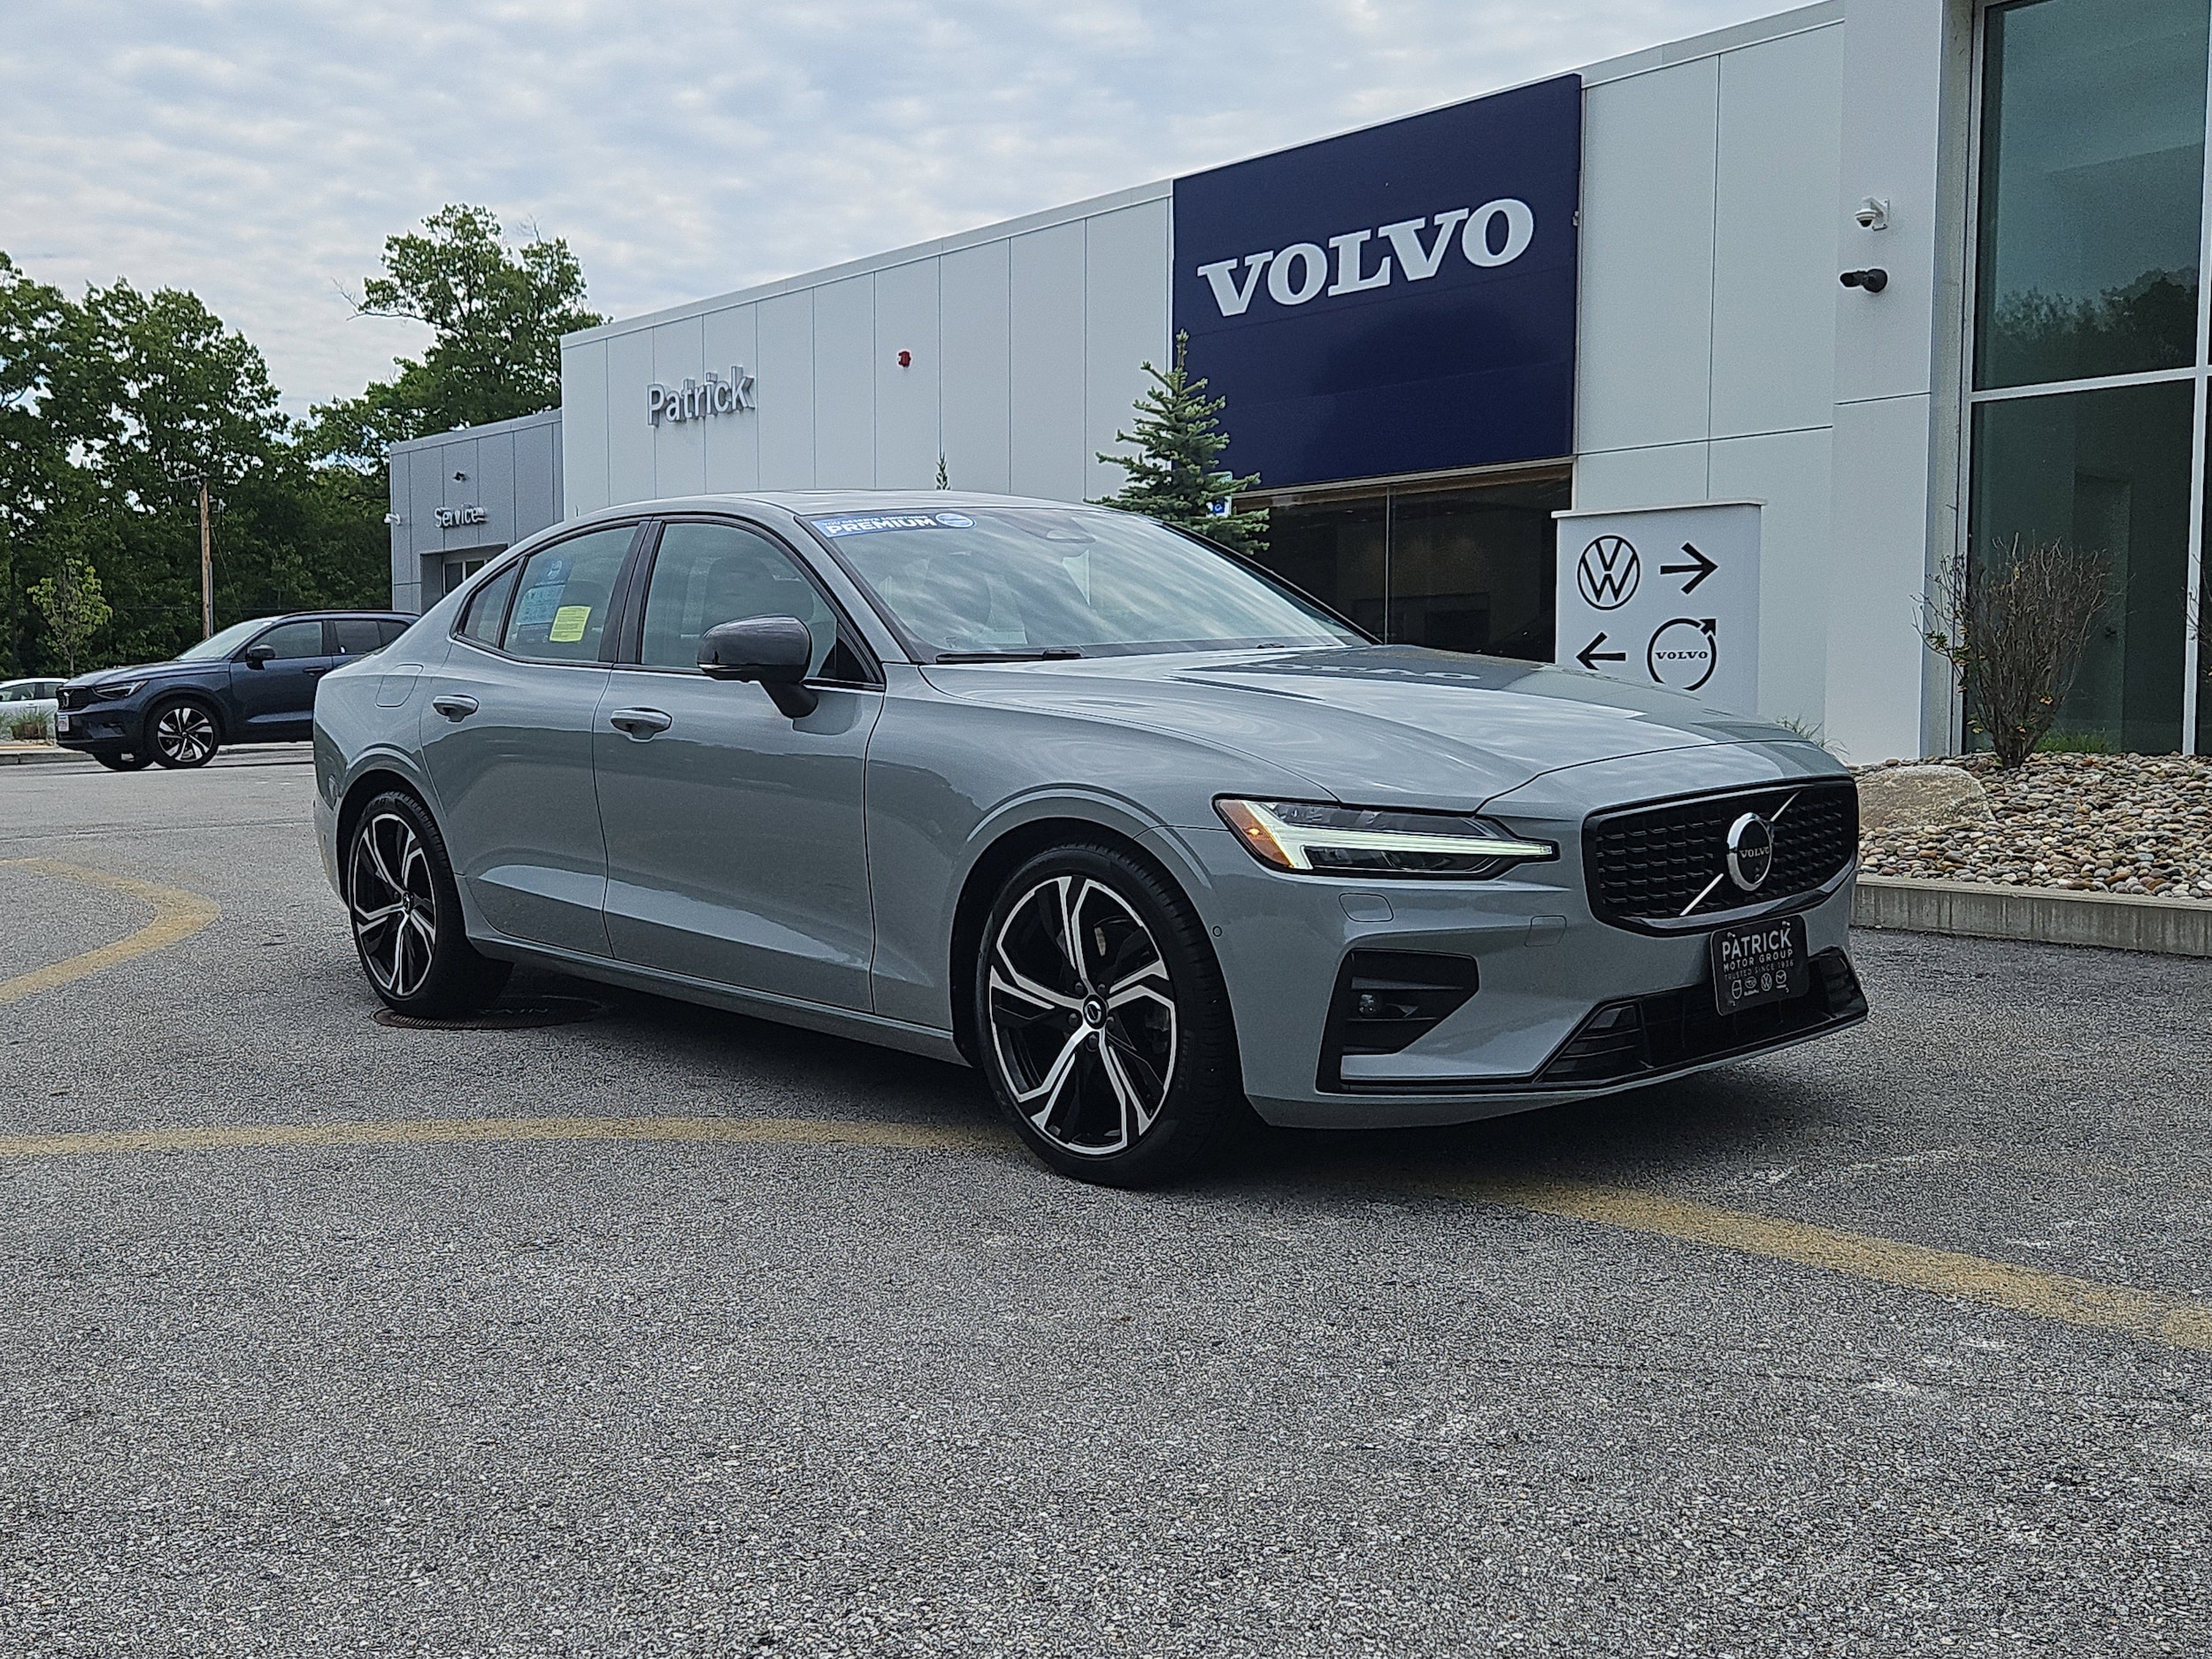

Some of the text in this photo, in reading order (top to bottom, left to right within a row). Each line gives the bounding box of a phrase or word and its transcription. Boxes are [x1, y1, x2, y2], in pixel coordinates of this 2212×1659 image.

[1197, 198, 1534, 317] VOLVO
[647, 365, 755, 426] Patrick
[434, 503, 485, 527] Service
[826, 518, 937, 534] PREMIUM
[1655, 650, 1709, 660] VOLVO
[1739, 846, 1770, 858] VOLVO
[1722, 927, 1793, 962] PATRICK
[1723, 949, 1793, 972] MOTOR GROUP
